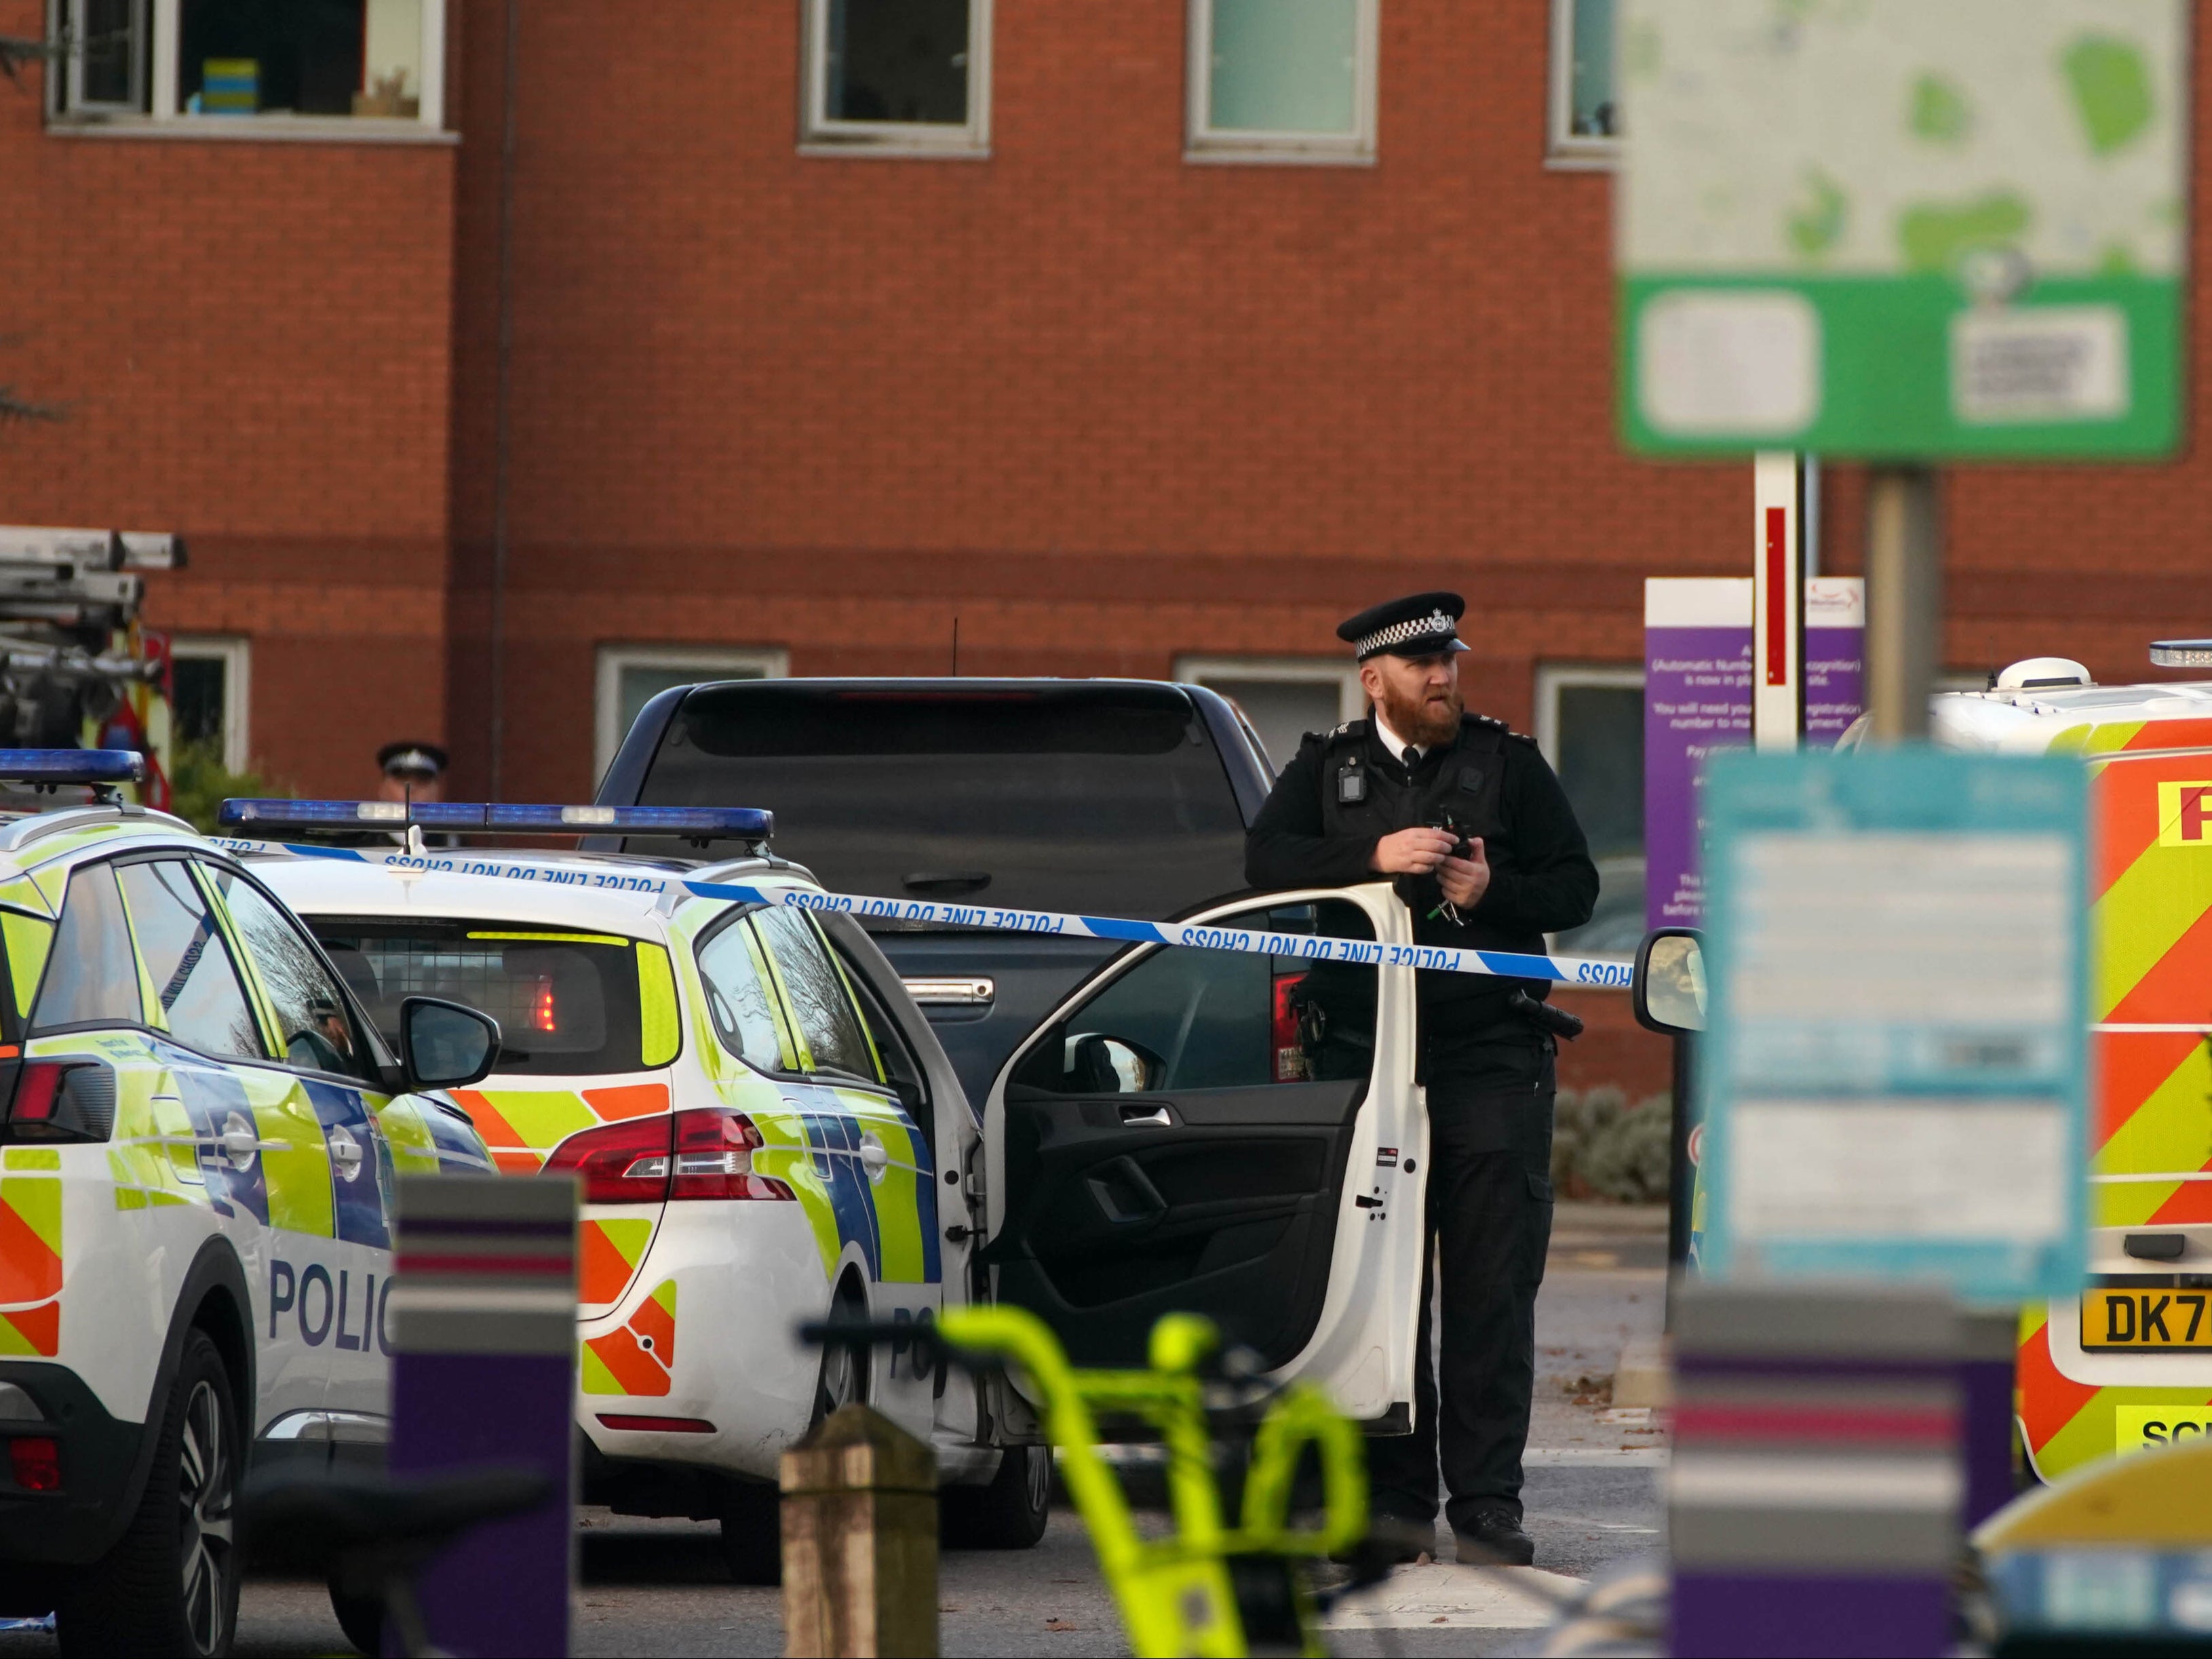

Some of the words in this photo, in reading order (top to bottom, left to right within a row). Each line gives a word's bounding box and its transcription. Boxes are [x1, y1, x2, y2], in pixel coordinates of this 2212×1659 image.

[1732, 718, 1751, 728] ma
[541, 870, 588, 886] LINE
[594, 875, 666, 894] POLICE
[784, 893, 853, 912] CROSS
[861, 899, 901, 918] NOT
[905, 903, 935, 921] DO
[942, 907, 987, 927] LINE
[992, 912, 1064, 934] POLICE
[1179, 928, 1249, 951] CROSS
[1258, 935, 1298, 956] NOT
[1302, 939, 1332, 960] DO
[1338, 942, 1384, 964] LINE
[1389, 946, 1461, 971] POLICE
[1576, 962, 1633, 987] ROSS
[269, 1260, 395, 1357] POLIC
[2106, 1295, 2212, 1342] DK7
[2143, 1421, 2212, 1449] SC
